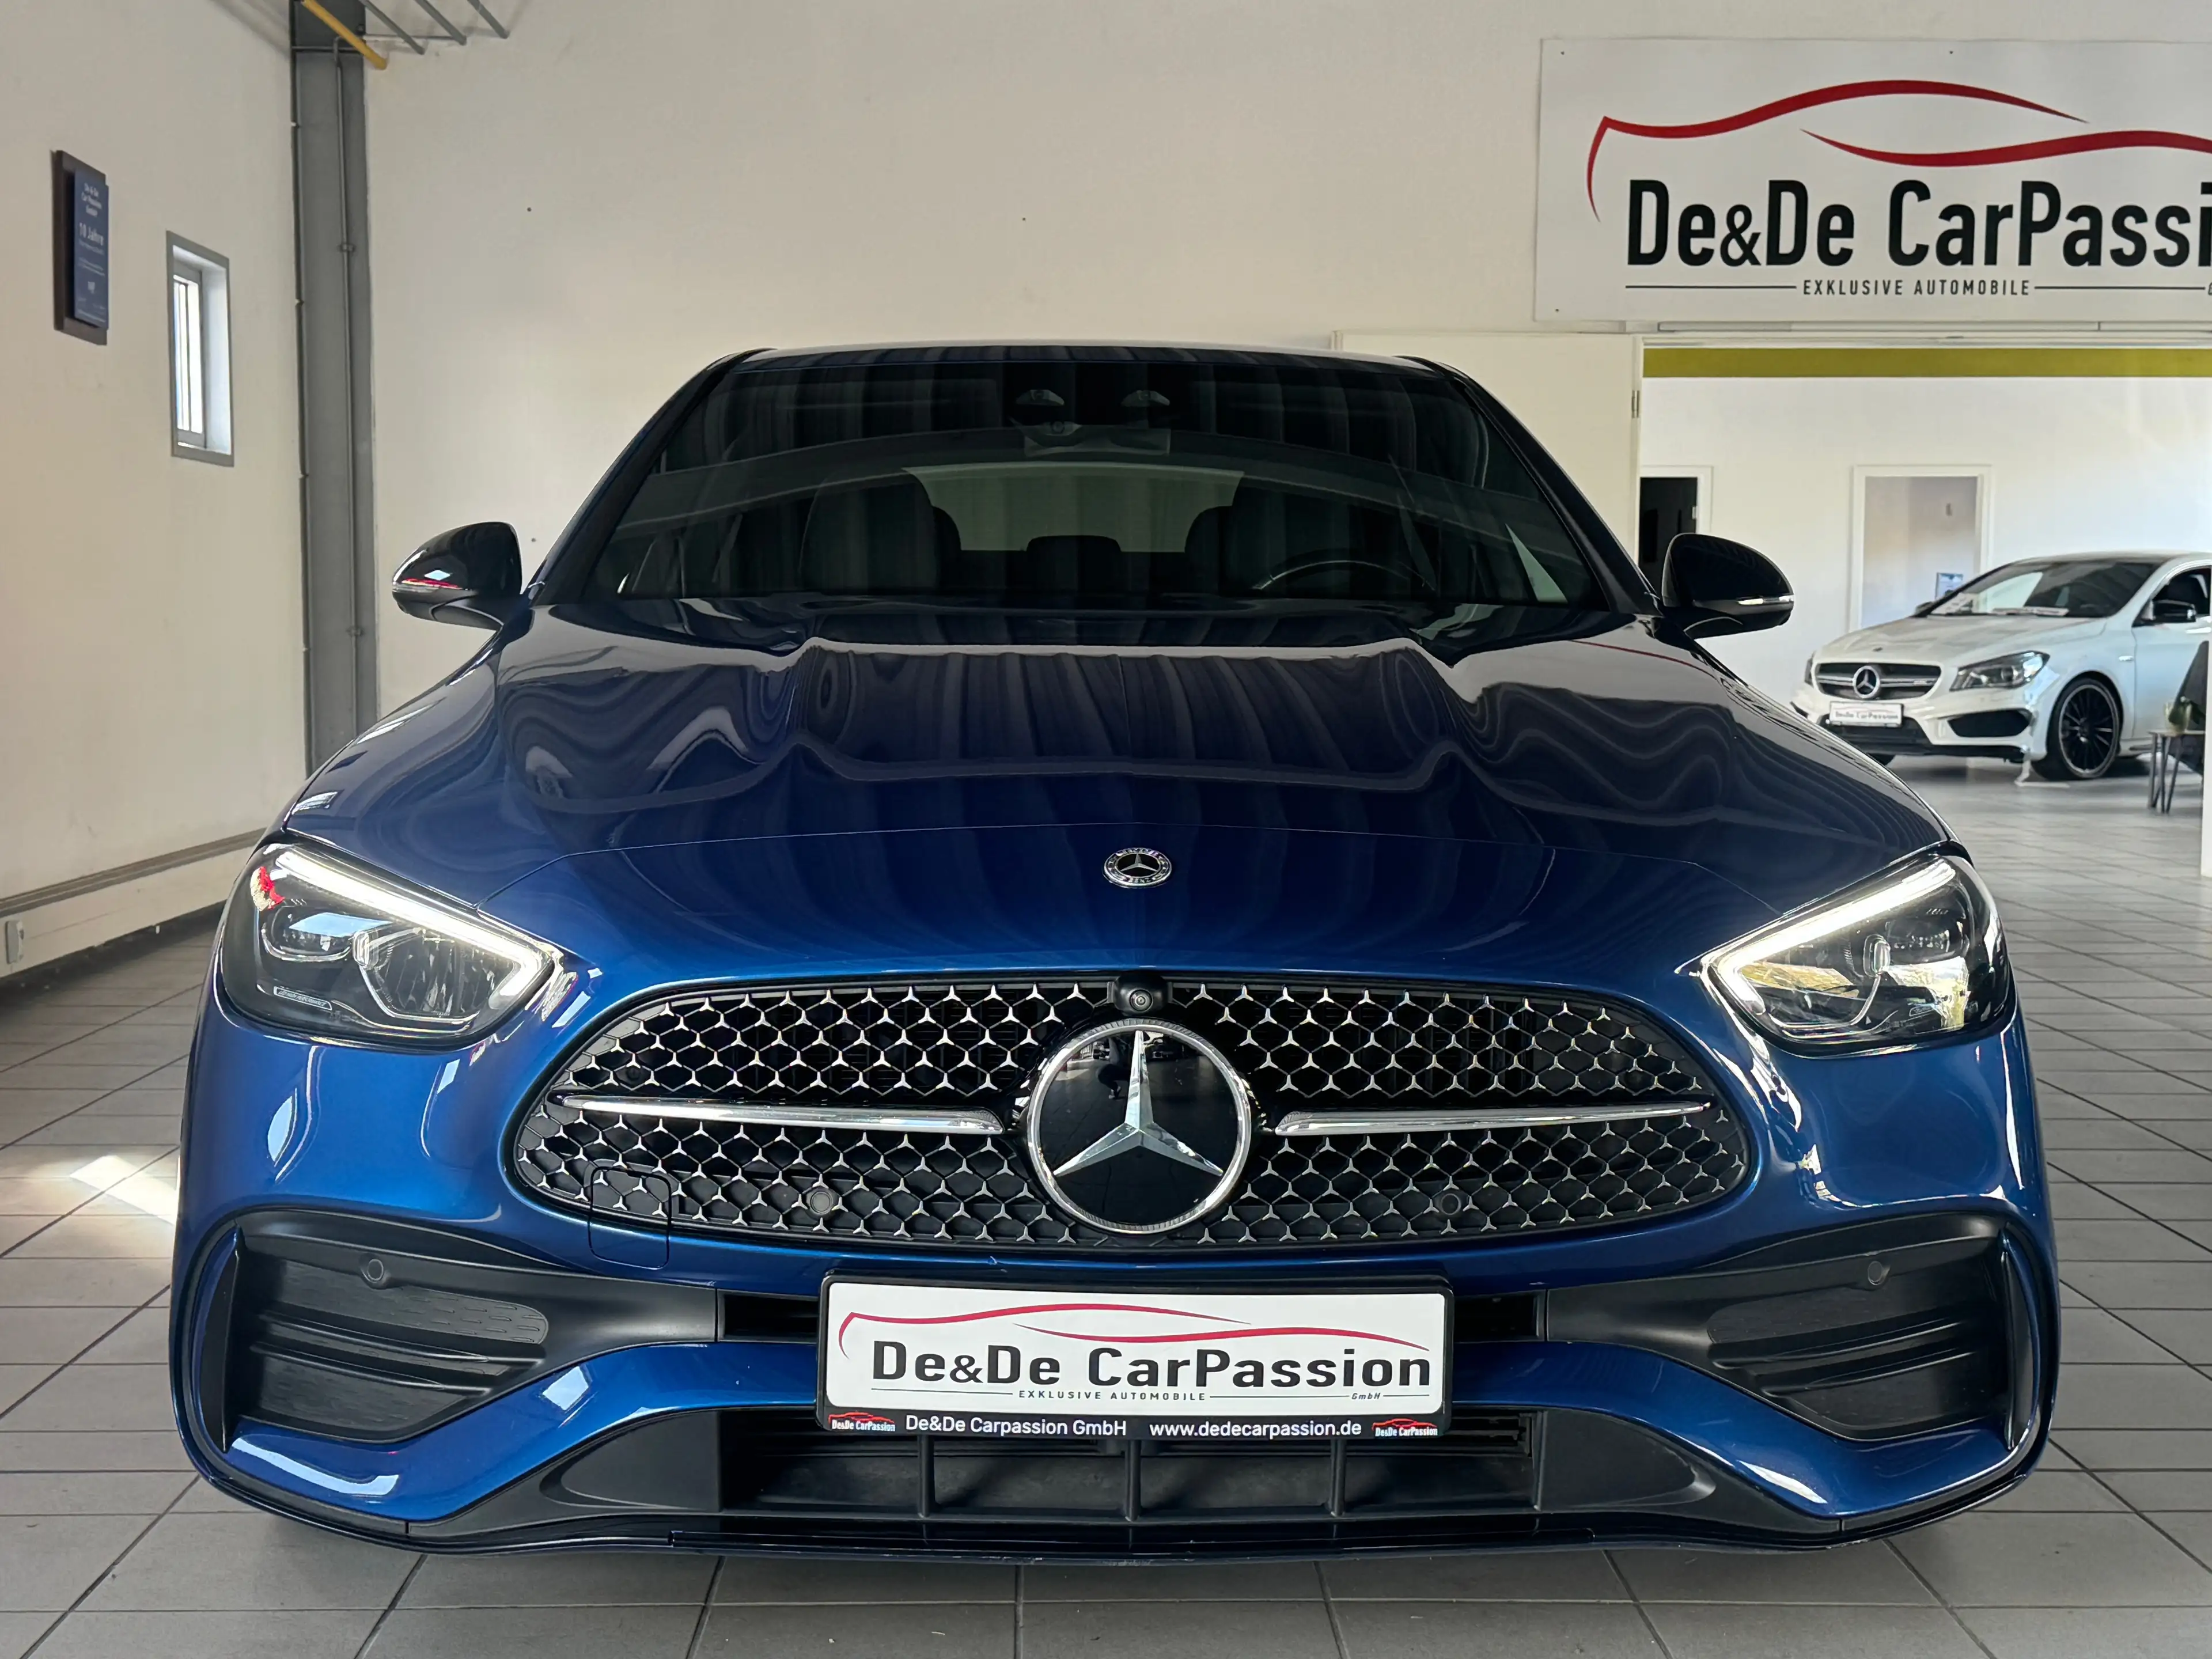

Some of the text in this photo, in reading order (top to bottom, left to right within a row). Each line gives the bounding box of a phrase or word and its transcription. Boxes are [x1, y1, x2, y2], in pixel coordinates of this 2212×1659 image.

[1627, 179, 1855, 267] De&De
[1803, 279, 2029, 296] EXKLUSIVE AUTOMOBILE
[873, 1340, 1430, 1388] De&De CarPassion
[1019, 1390, 1101, 1399] EXKLUSIVE
[1110, 1392, 1205, 1400] AUTOMOBILE
[855, 1420, 896, 1431] CarPassion
[906, 1415, 1127, 1437] De&De Carpassion GmbH
[1149, 1420, 1362, 1440] www.dedecarpassion.de
[1399, 1427, 1438, 1436] CarPassion
